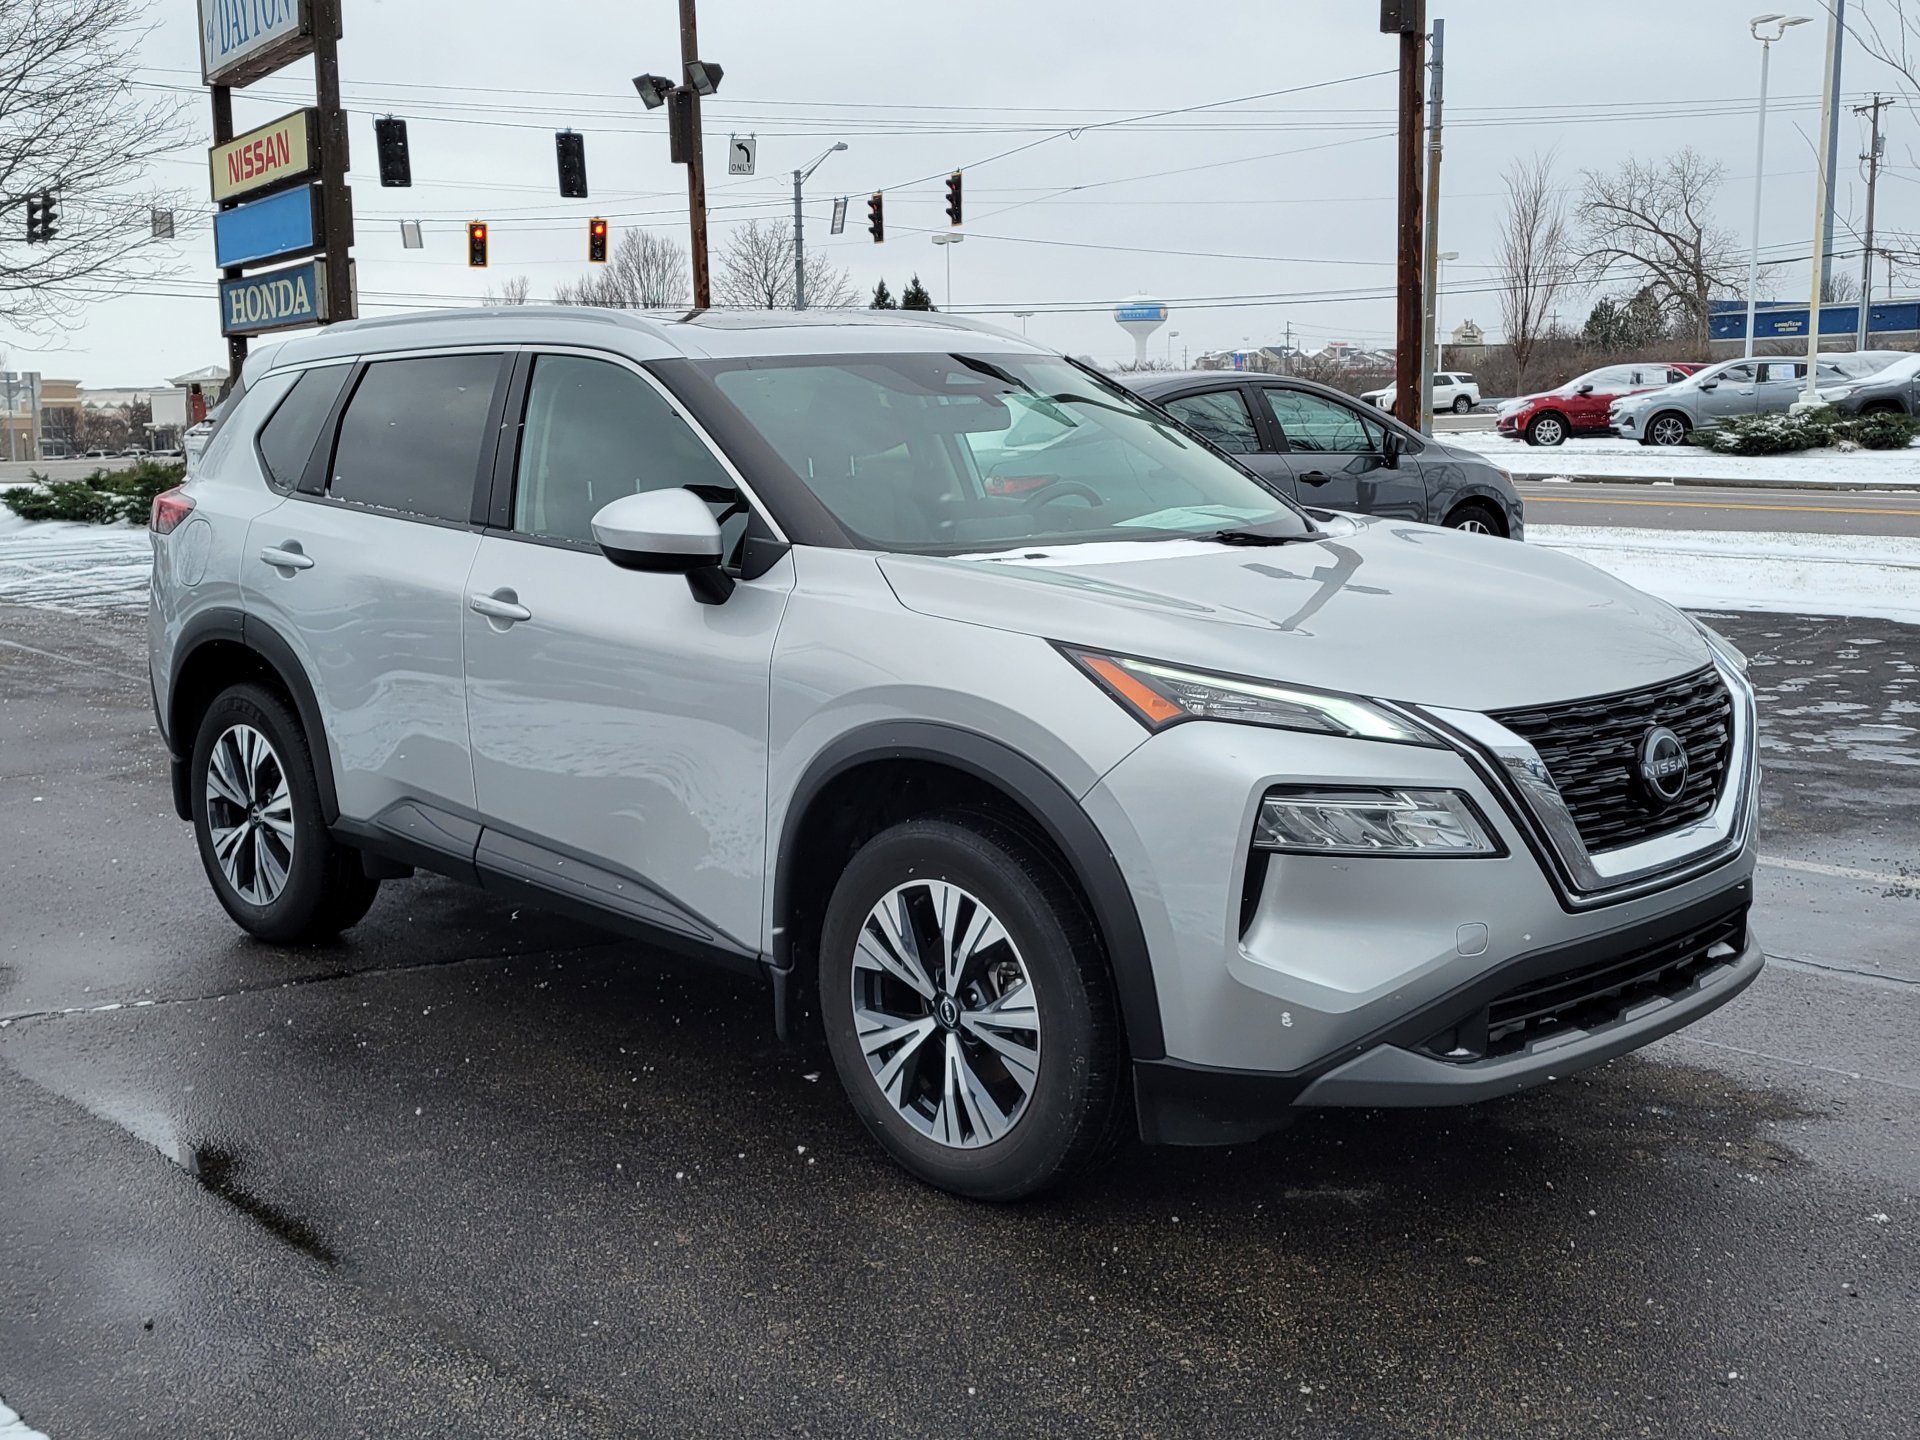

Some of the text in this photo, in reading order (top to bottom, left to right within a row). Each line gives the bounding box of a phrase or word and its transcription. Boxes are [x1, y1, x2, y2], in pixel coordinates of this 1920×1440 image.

[227, 129, 290, 185] NISSAN
[731, 163, 752, 171] ONLY
[229, 275, 311, 325] HONDA
